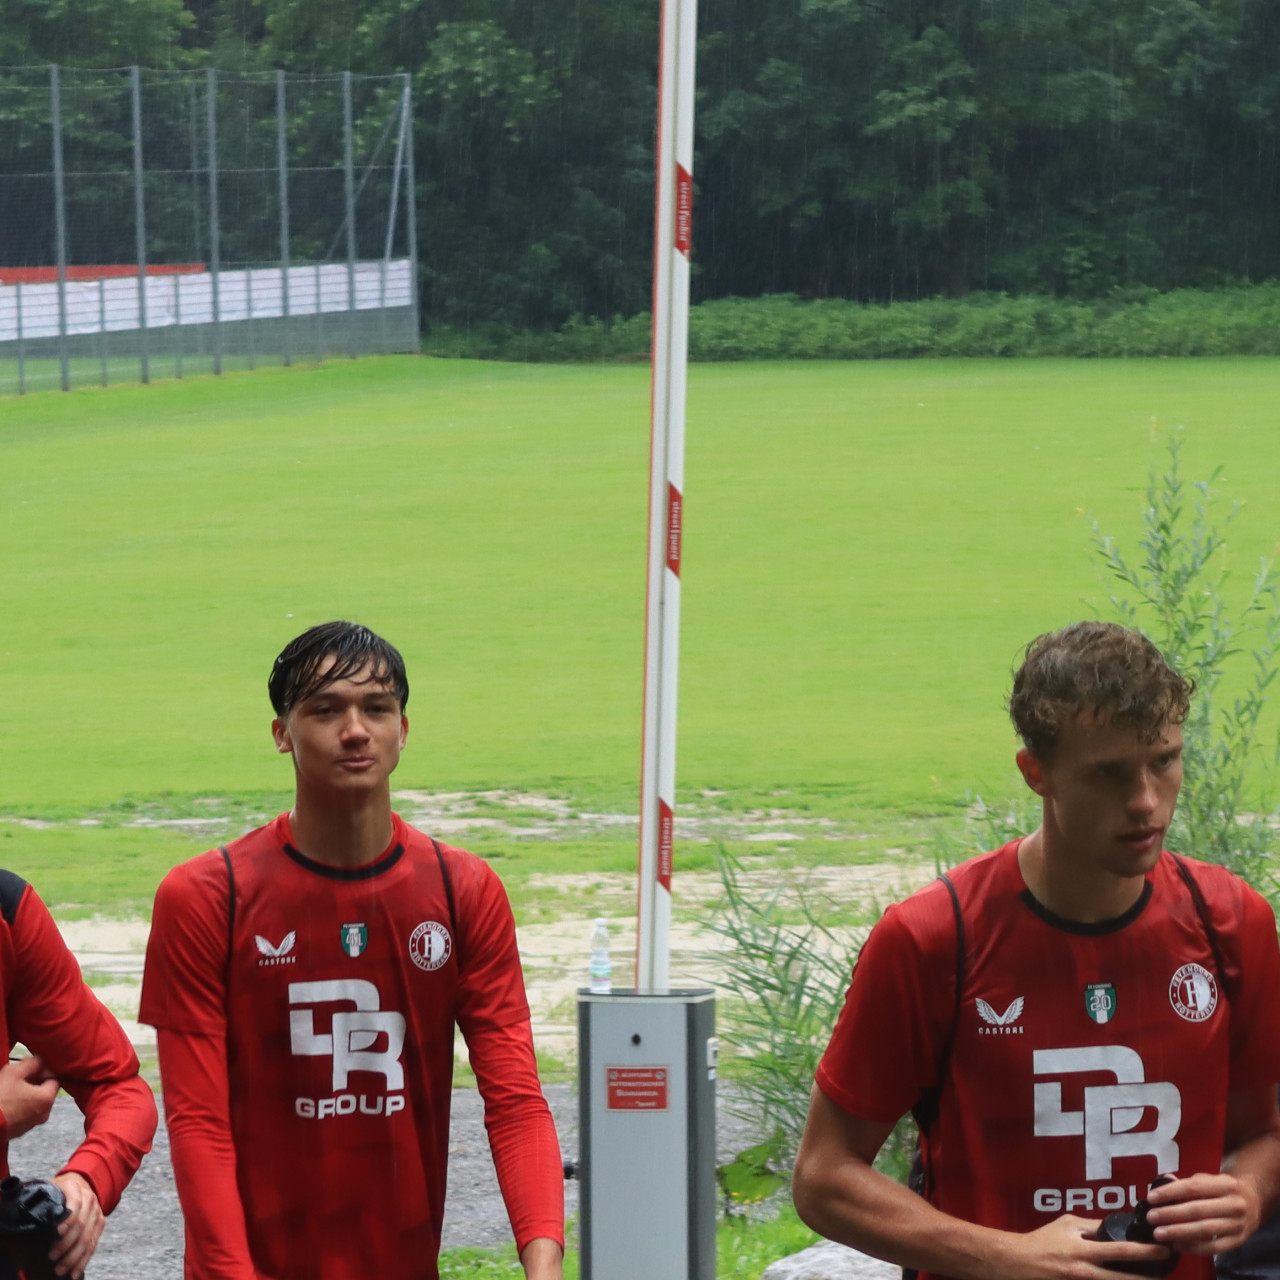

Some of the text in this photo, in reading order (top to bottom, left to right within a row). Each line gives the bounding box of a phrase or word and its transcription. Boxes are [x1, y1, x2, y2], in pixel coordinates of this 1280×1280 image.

[259, 956, 296, 967] CASTORE
[1090, 995, 1112, 1011] 20
[288, 979, 406, 1092] DR
[978, 1026, 1024, 1035] CASTORE
[295, 1094, 405, 1120] GROUP
[1032, 1045, 1182, 1181] DR
